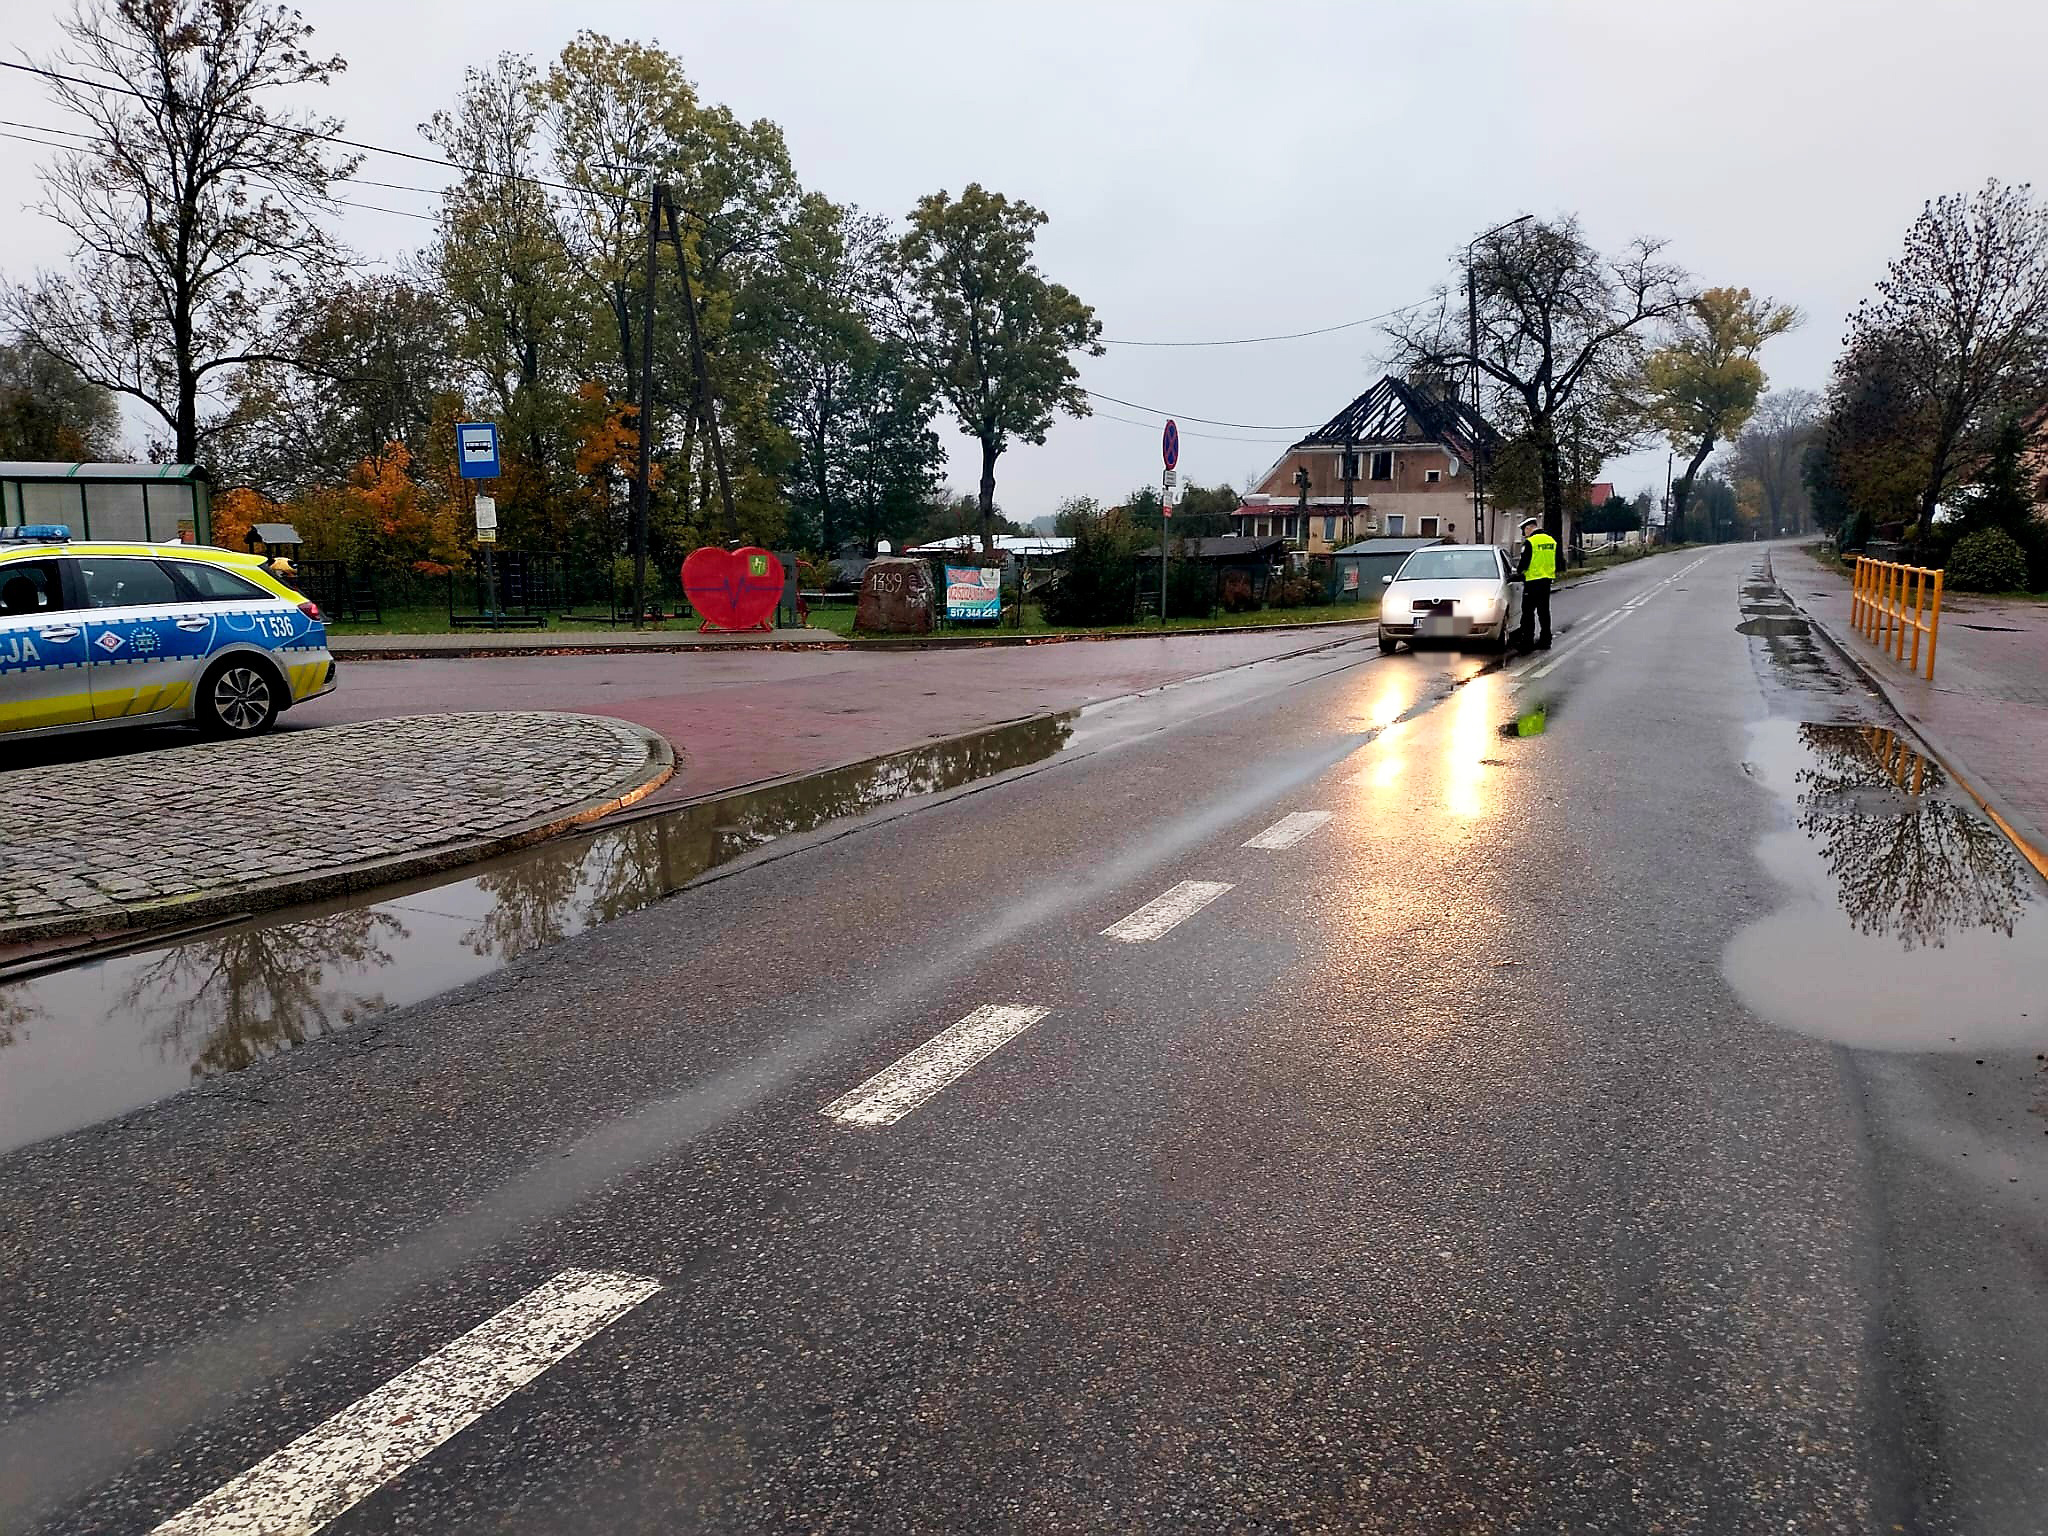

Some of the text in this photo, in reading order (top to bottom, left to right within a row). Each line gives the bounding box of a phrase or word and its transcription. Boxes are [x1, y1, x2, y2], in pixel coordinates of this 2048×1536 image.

[871, 572, 903, 593] 1389
[950, 608, 964, 617] 517
[255, 616, 294, 638] T 536
